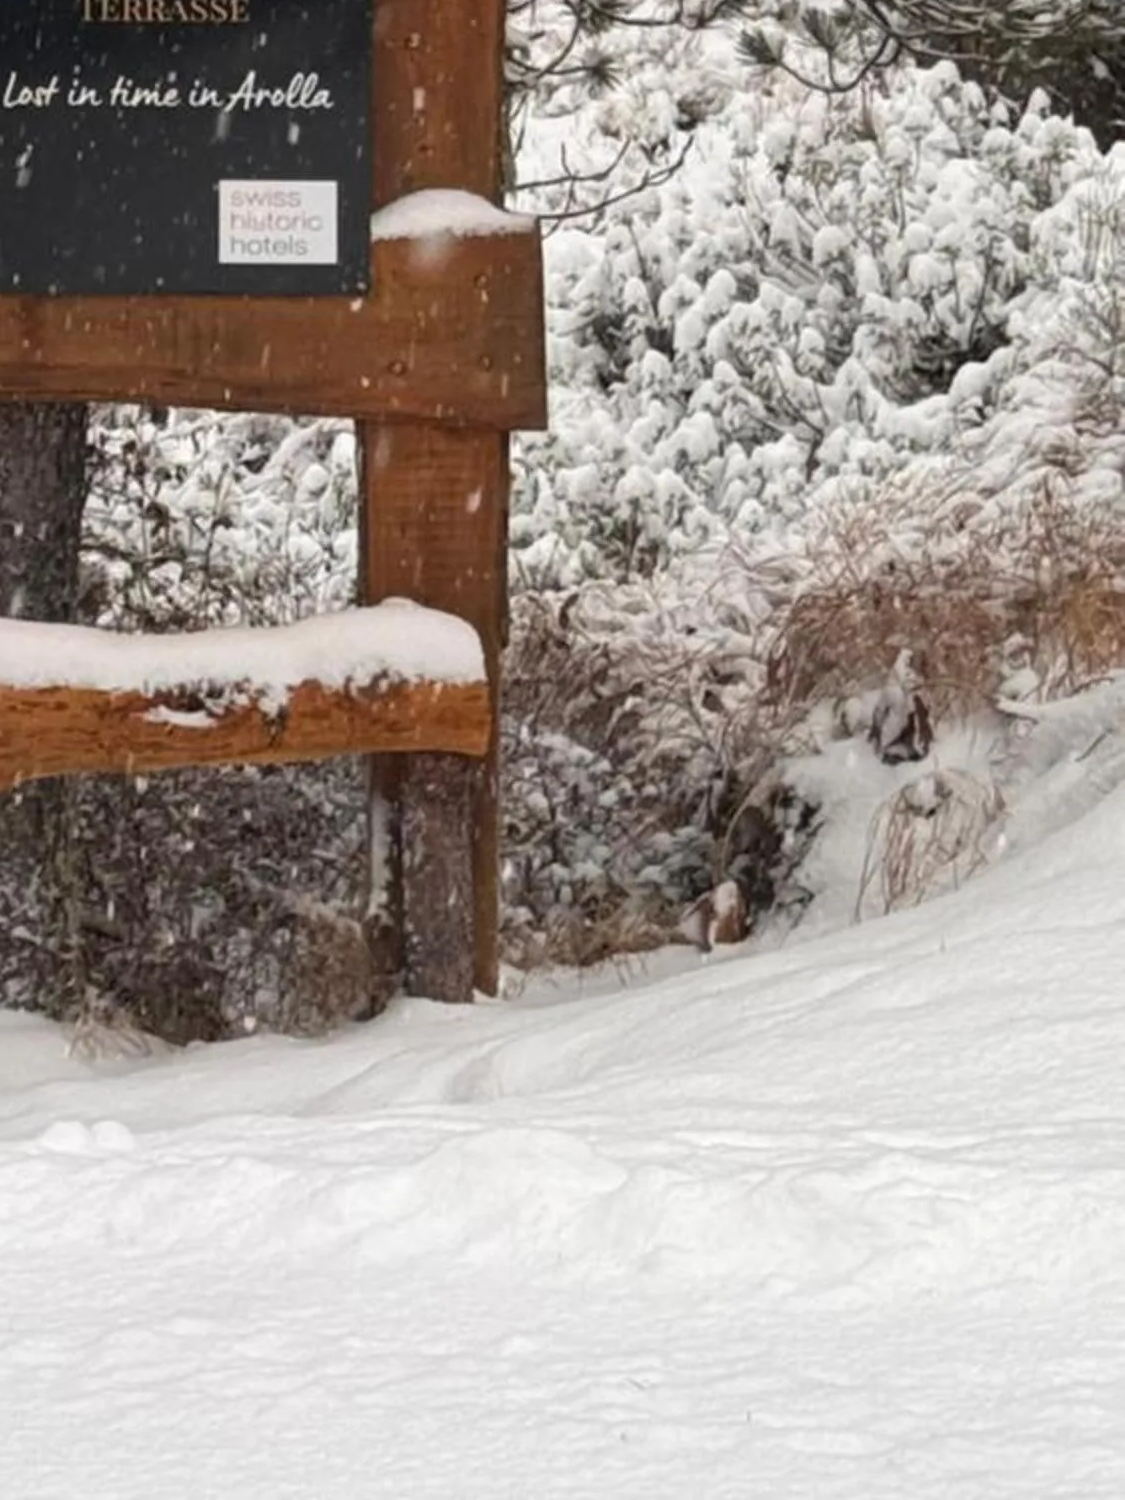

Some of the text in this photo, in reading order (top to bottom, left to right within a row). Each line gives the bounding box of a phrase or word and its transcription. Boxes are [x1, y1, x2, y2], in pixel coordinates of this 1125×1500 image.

[3, 70, 334, 112] Lost in time in Arolla
[230, 235, 309, 256] hotels
